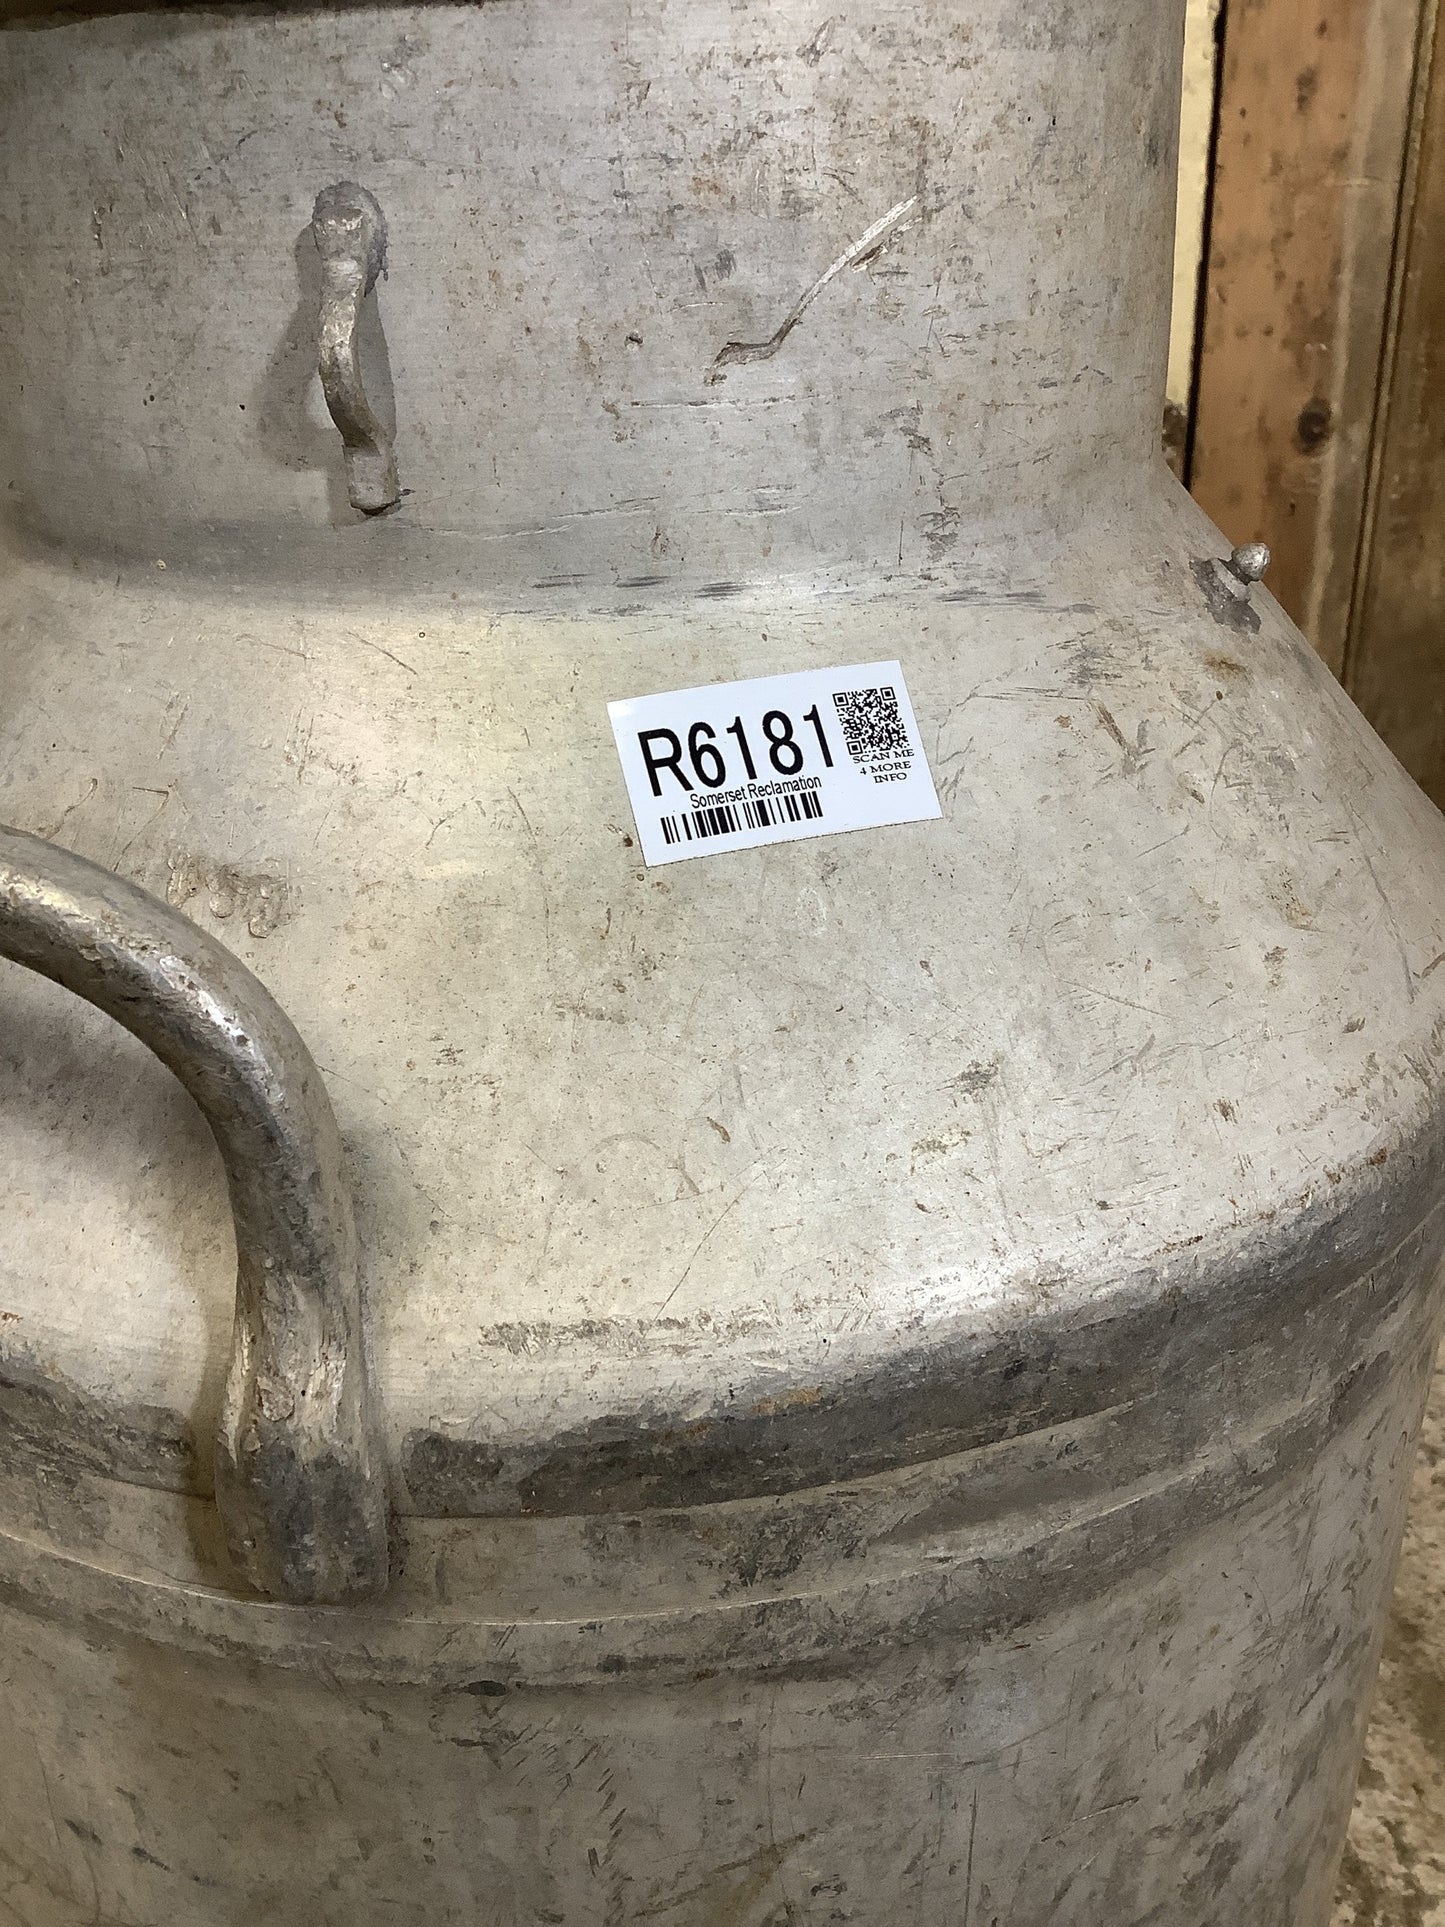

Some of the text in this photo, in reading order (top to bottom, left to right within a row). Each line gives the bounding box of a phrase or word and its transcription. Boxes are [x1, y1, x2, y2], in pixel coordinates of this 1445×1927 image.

[637, 704, 834, 797] R6181
[853, 749, 915, 764] SCAN ME
[860, 761, 911, 775] 4 MORE
[873, 772, 907, 784] INFO
[690, 775, 822, 809] Somerset Reclamation
